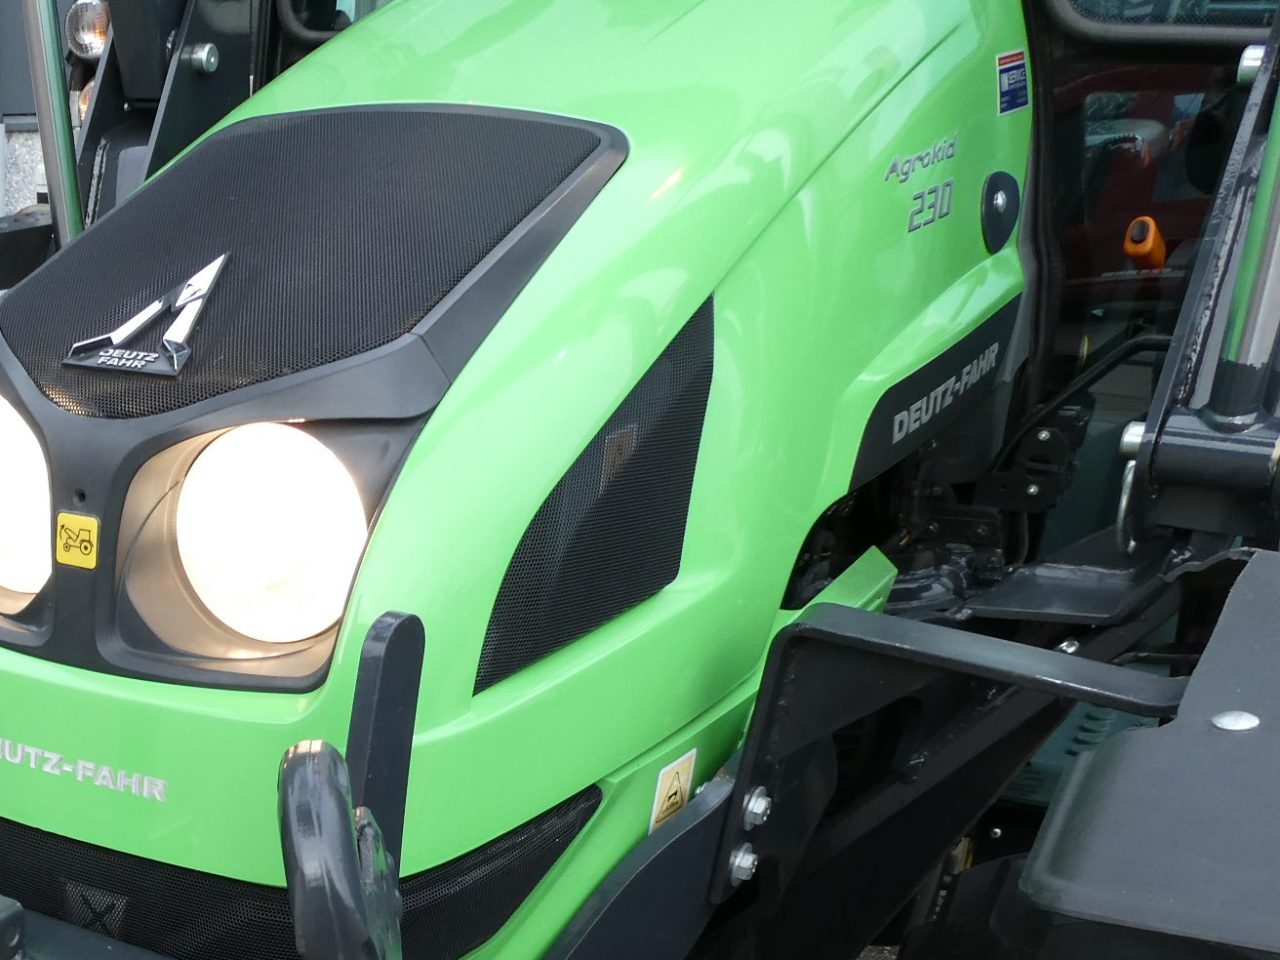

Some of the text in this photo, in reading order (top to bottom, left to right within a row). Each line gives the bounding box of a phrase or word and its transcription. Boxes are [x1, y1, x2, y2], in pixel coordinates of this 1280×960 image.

[885, 134, 956, 184] Agrokid
[908, 179, 953, 233] 230
[97, 356, 146, 368] FAHR
[99, 349, 159, 361] DEUTZ
[892, 342, 999, 444] DEUTZ-FAHR
